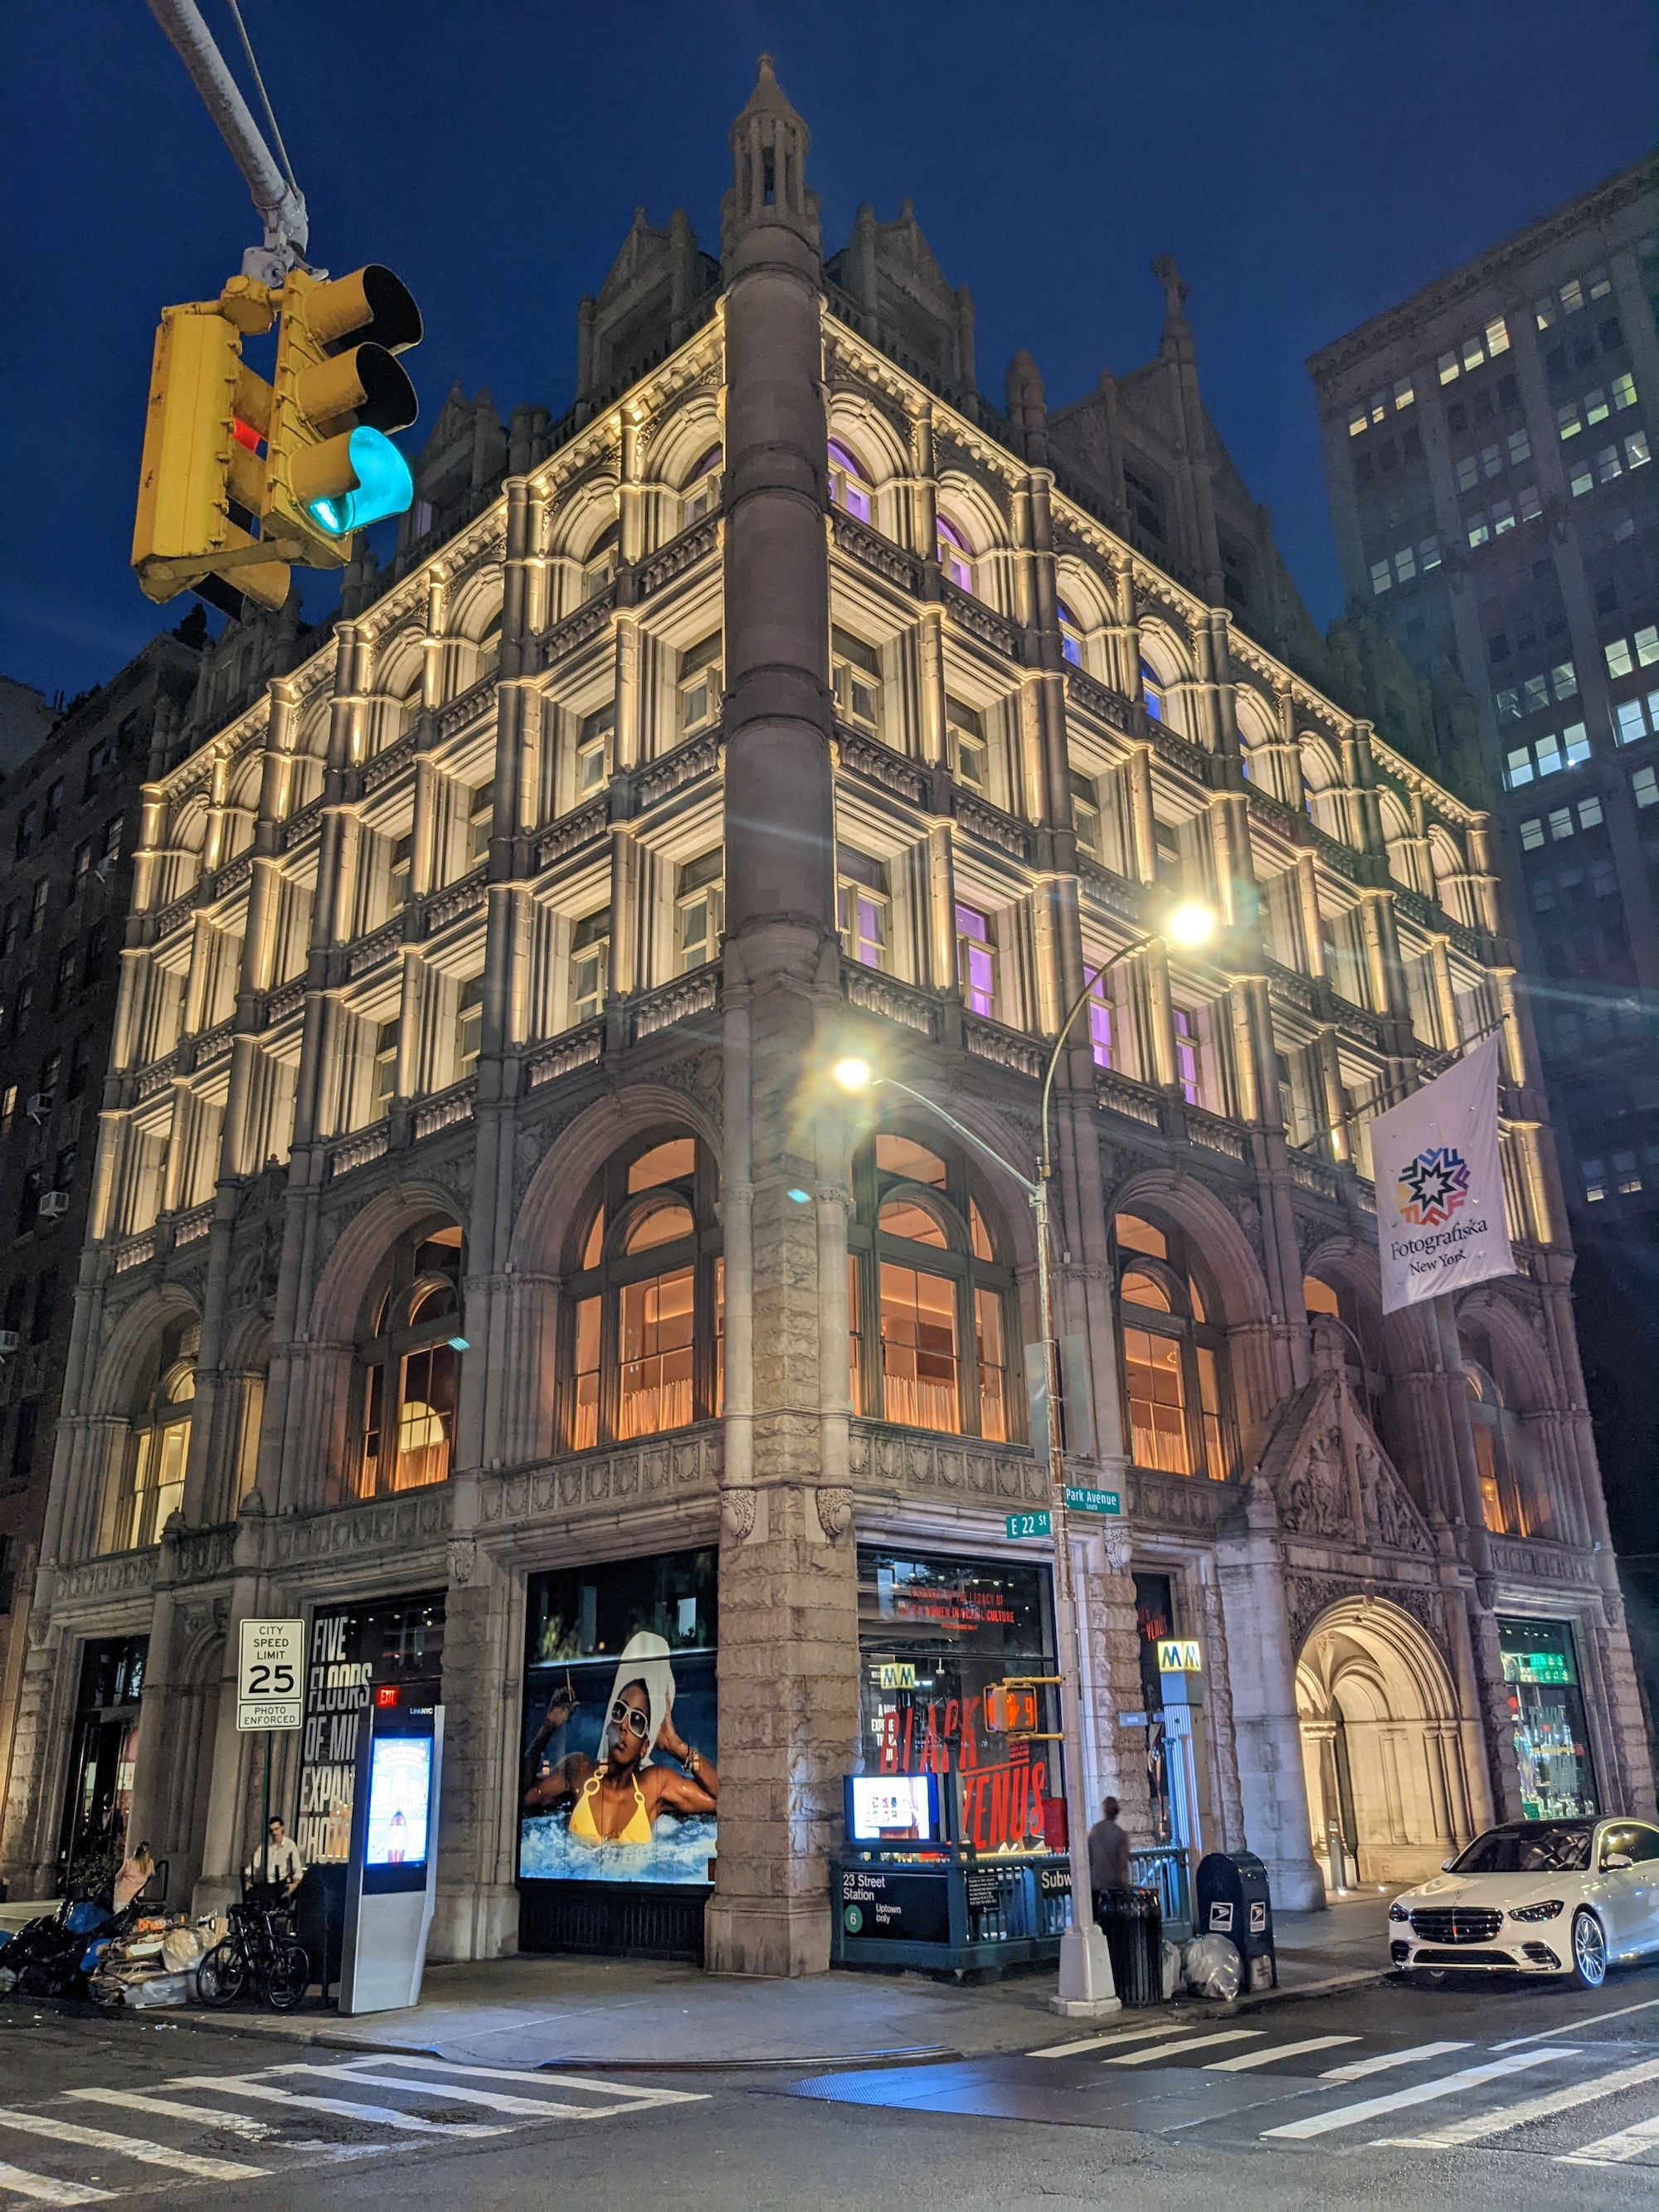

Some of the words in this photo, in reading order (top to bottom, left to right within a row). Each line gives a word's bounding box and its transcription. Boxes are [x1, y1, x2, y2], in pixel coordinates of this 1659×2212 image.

[1391, 1218, 1488, 1260] Fotografiska
[1409, 1259, 1438, 1276] New
[1438, 1248, 1467, 1267] York
[1066, 1488, 1085, 1502] Park
[1087, 1491, 1117, 1506] Avenue
[1011, 1518, 1018, 1535] E
[1022, 1516, 1034, 1534] 22
[1039, 1514, 1047, 1526] St
[986, 1609, 1015, 1624] CULTURE
[259, 1626, 284, 1635] CITY
[253, 1638, 289, 1647] SPEED
[312, 1616, 348, 1663] FIVE
[257, 1650, 285, 1660] LIMIT
[249, 1665, 294, 1694] 25
[308, 1662, 372, 1713] FLOORS
[380, 1689, 396, 1704] EXIT
[255, 1706, 286, 1715] PHOTO
[244, 1715, 296, 1725] ENFORCED
[304, 1716, 327, 1761] OF
[299, 1764, 356, 1812] EXPAN
[961, 1761, 1045, 1850] VENUS
[843, 1874, 855, 1887] 23
[858, 1874, 886, 1888] Street
[1041, 1870, 1072, 1889] Subw
[843, 1887, 875, 1901] Station
[875, 1903, 902, 1914] Uptown
[849, 1913, 857, 1924] 6
[876, 1913, 891, 1924] only
